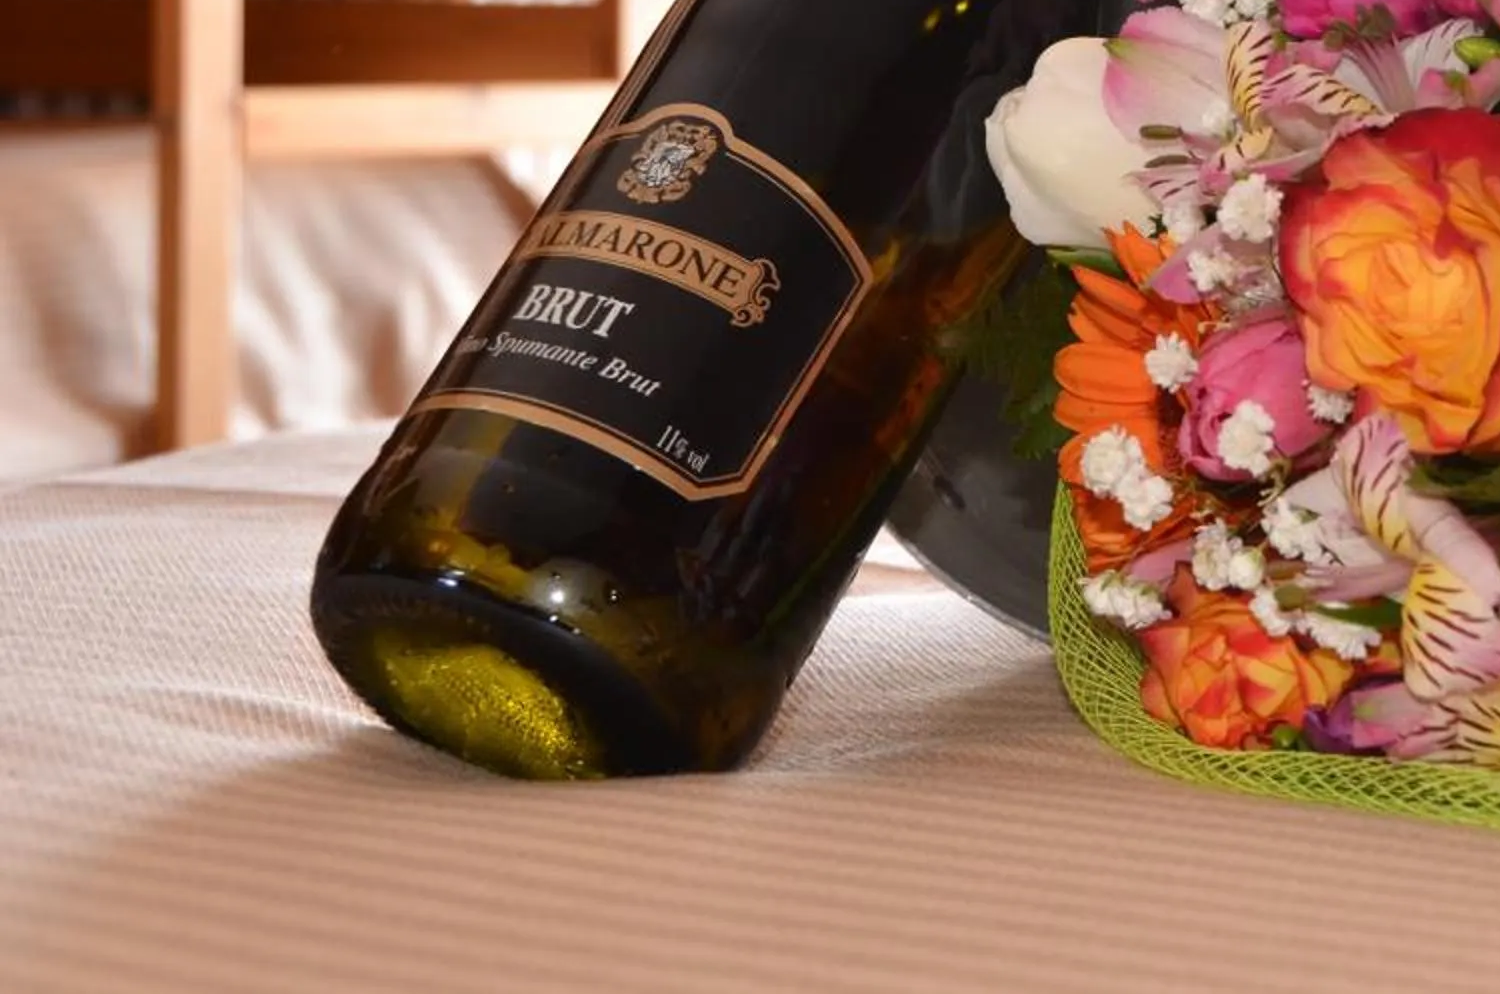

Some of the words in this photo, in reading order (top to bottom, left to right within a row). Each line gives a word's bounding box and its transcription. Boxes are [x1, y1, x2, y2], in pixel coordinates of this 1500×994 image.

[513, 284, 635, 338] BRUT
[486, 331, 597, 370] Spumante
[598, 357, 662, 397] Brut
